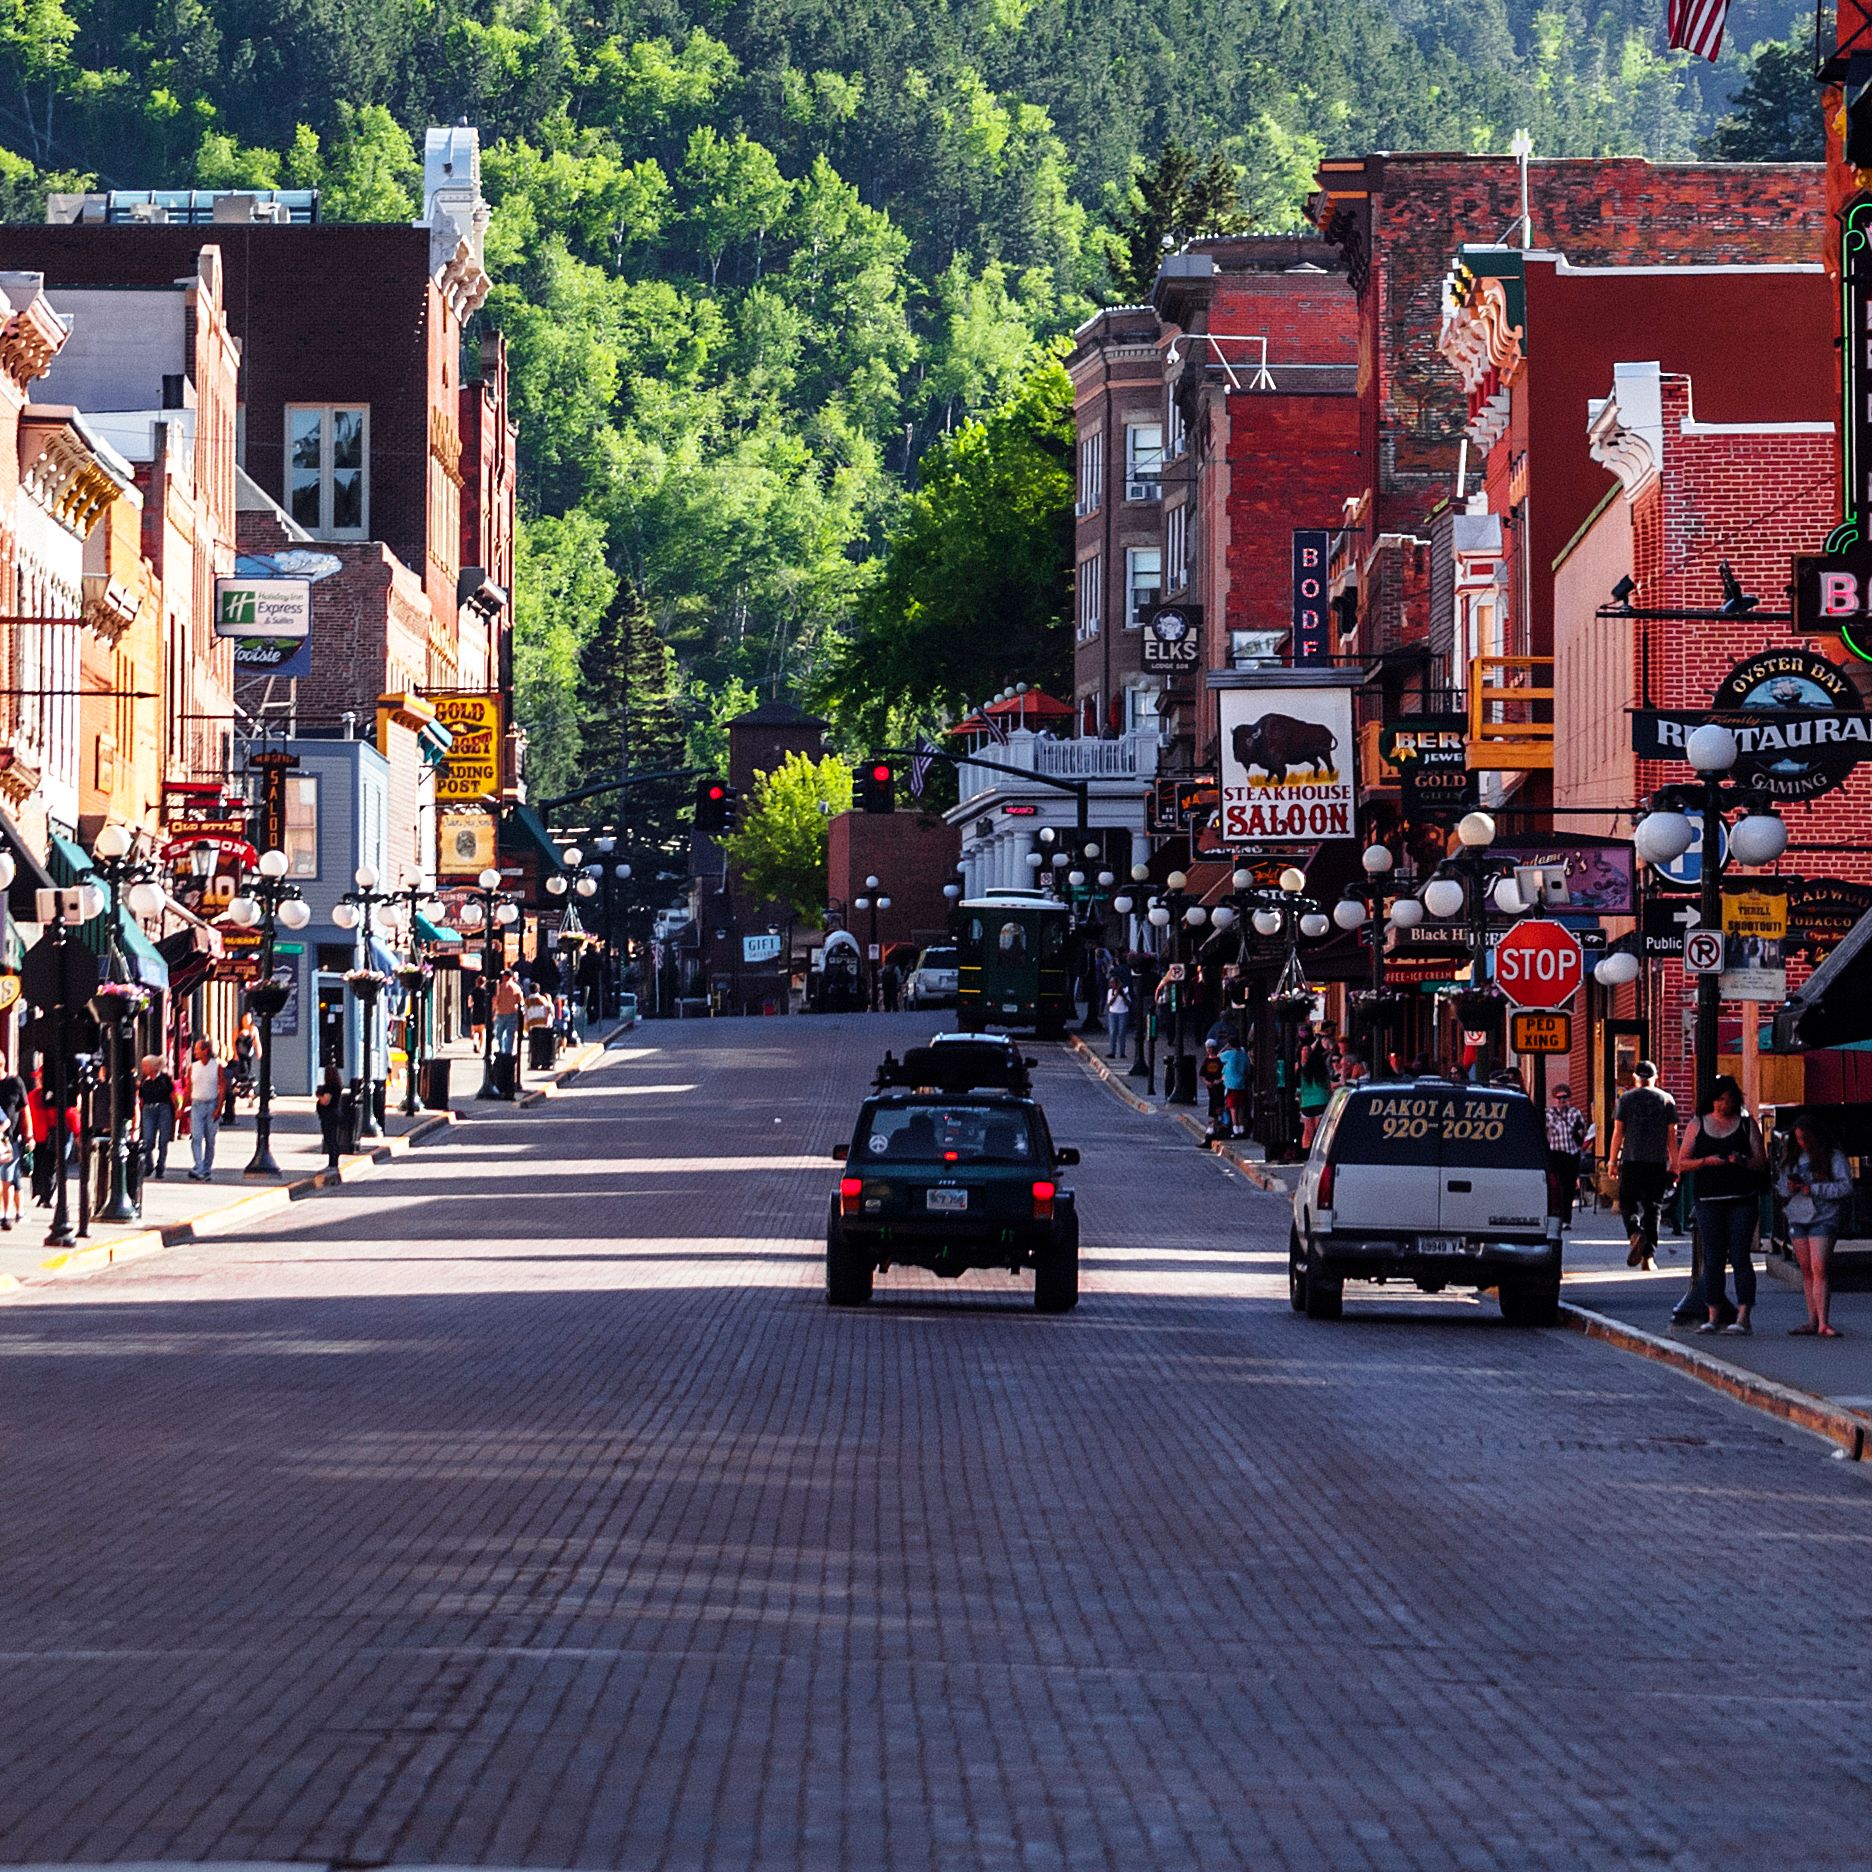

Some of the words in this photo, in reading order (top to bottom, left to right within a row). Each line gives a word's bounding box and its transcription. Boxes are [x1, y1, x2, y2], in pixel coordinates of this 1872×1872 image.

[258, 592, 288, 602] Holiday
[258, 601, 303, 616] Express
[1145, 642, 1198, 660] ELKS
[1151, 662, 1174, 670] LODGE
[1731, 656, 1805, 694] OYSTER
[1809, 665, 1849, 695] BAY
[435, 701, 486, 721] GOLD
[1424, 752, 1463, 764] JEWE
[448, 765, 495, 779] ADING
[436, 779, 481, 794] POST
[1414, 775, 1467, 787] GOLD
[1751, 772, 1828, 795] GAMING
[1224, 784, 1351, 802] STEAKHOUSE
[269, 770, 279, 847] SALOO
[1227, 802, 1351, 837] SALOON
[171, 822, 198, 833] OLD
[201, 821, 243, 832] STYLE
[1411, 928, 1448, 941] Black
[748, 938, 775, 951] GIFT
[1646, 937, 1683, 950] Public
[1501, 948, 1576, 980] STOP
[1410, 971, 1423, 981] ICE
[1425, 970, 1455, 981] CREAM
[1526, 1018, 1556, 1031] PED
[1524, 1034, 1559, 1047] XING
[1464, 1101, 1509, 1120] TAXI
